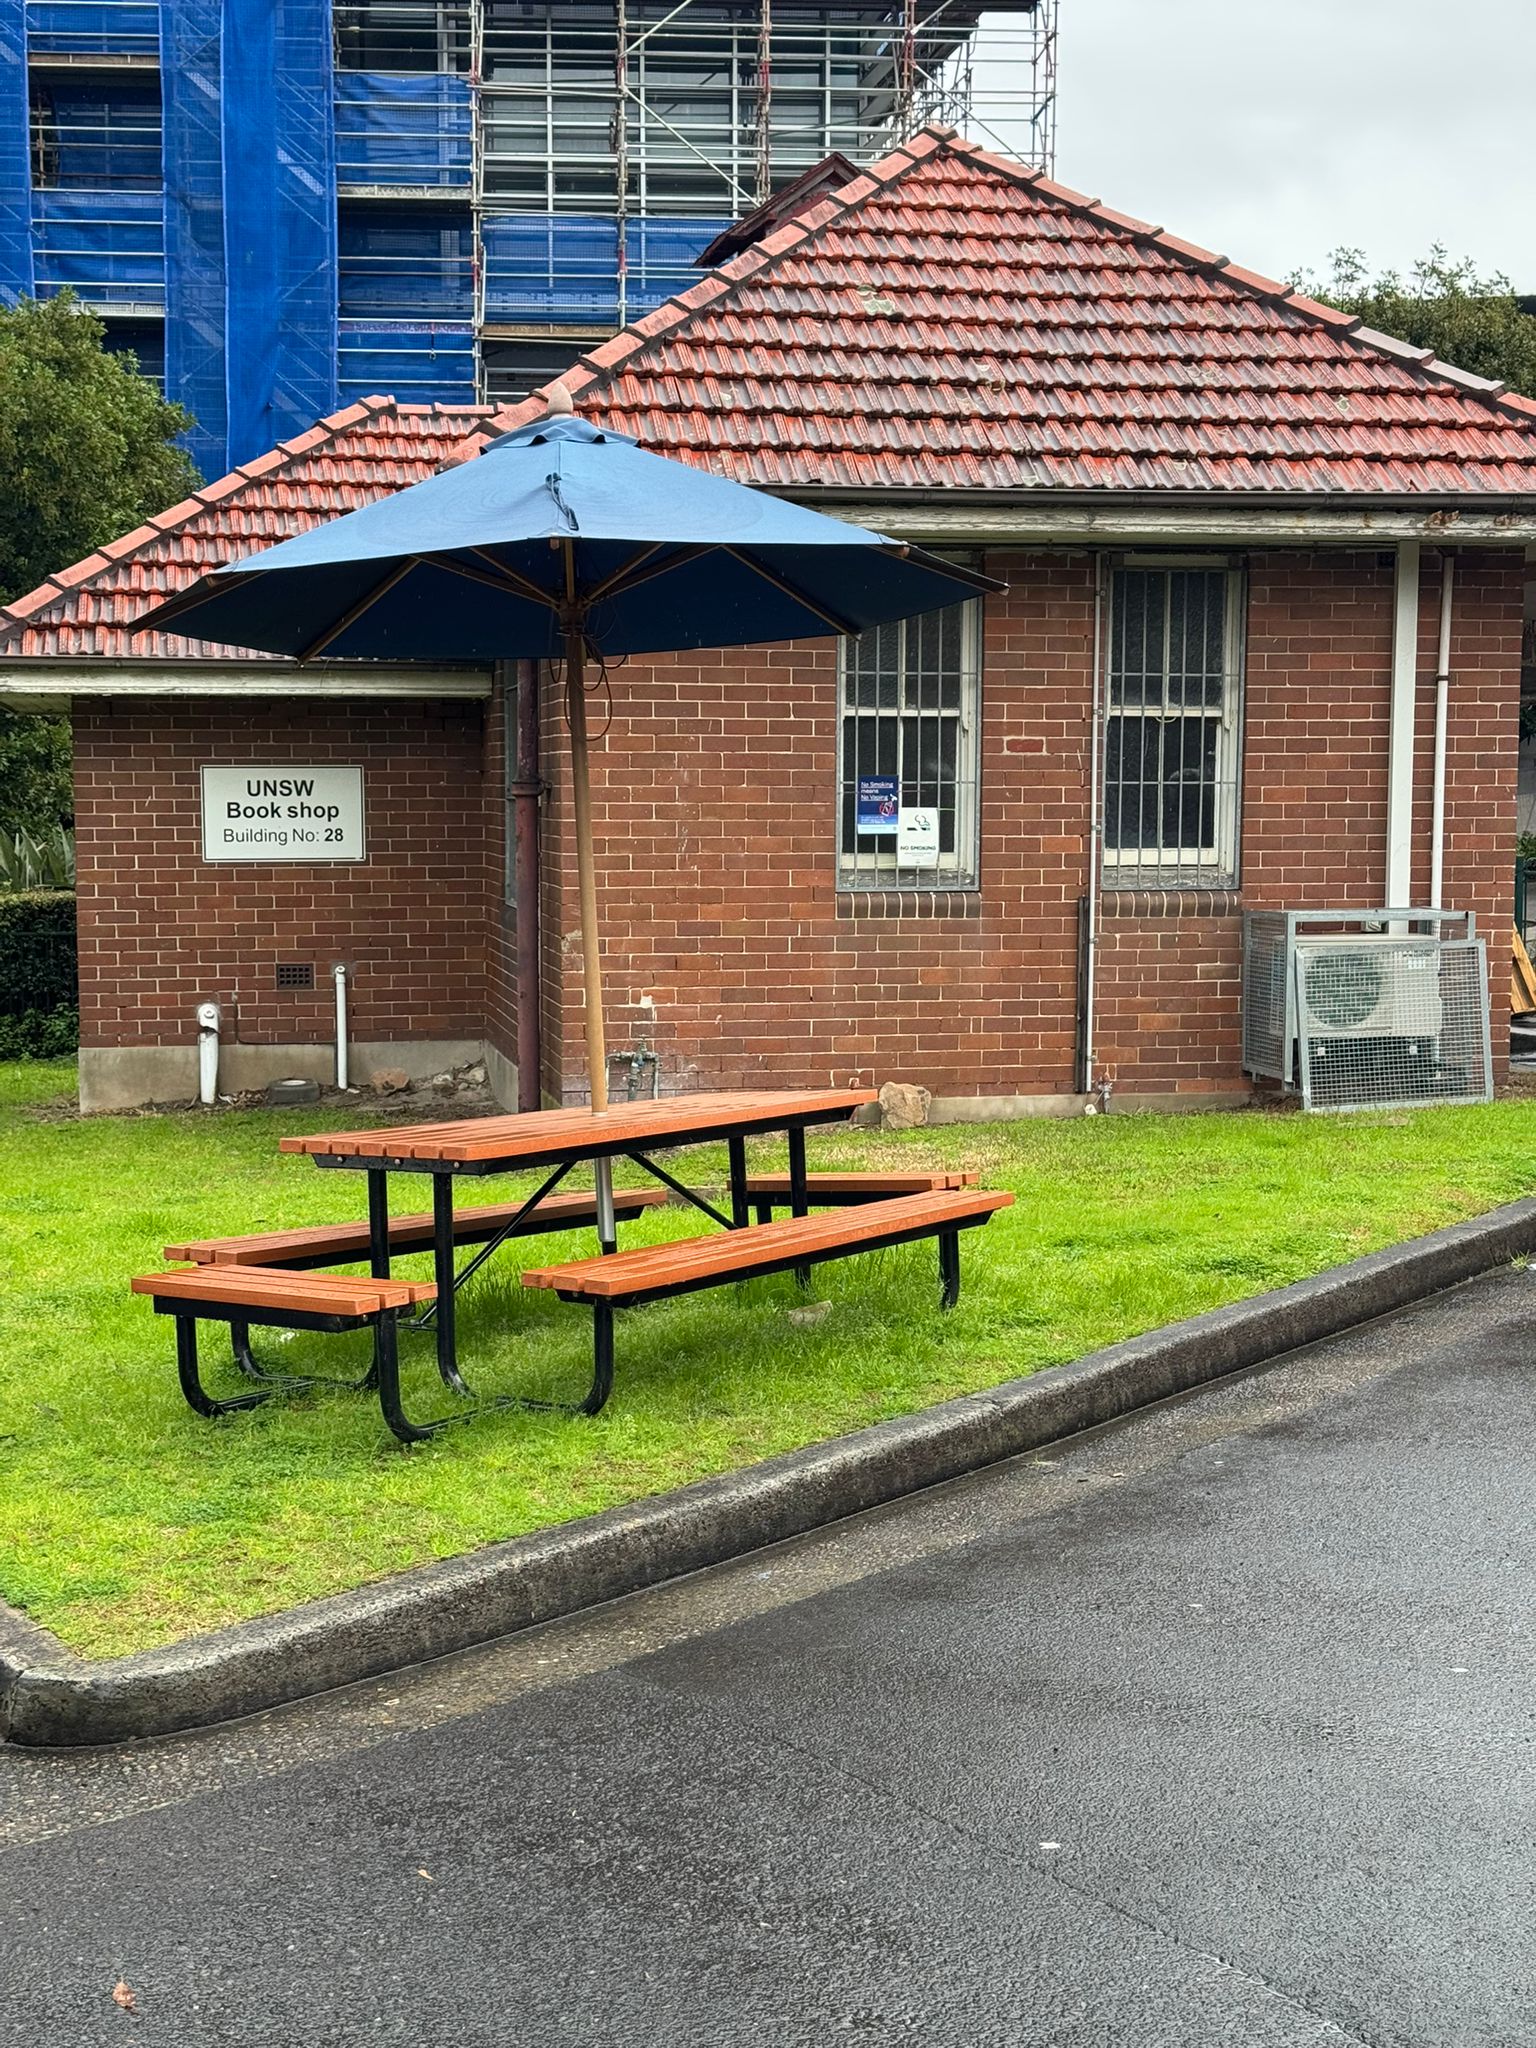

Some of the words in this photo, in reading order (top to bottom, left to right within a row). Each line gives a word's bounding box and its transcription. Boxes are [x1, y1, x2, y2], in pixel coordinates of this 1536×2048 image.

[247, 780, 314, 796] UNSW
[227, 802, 281, 818] Book
[287, 802, 339, 822] shop
[224, 829, 287, 845] Building
[293, 829, 319, 842] No:
[324, 828, 343, 841] 28
